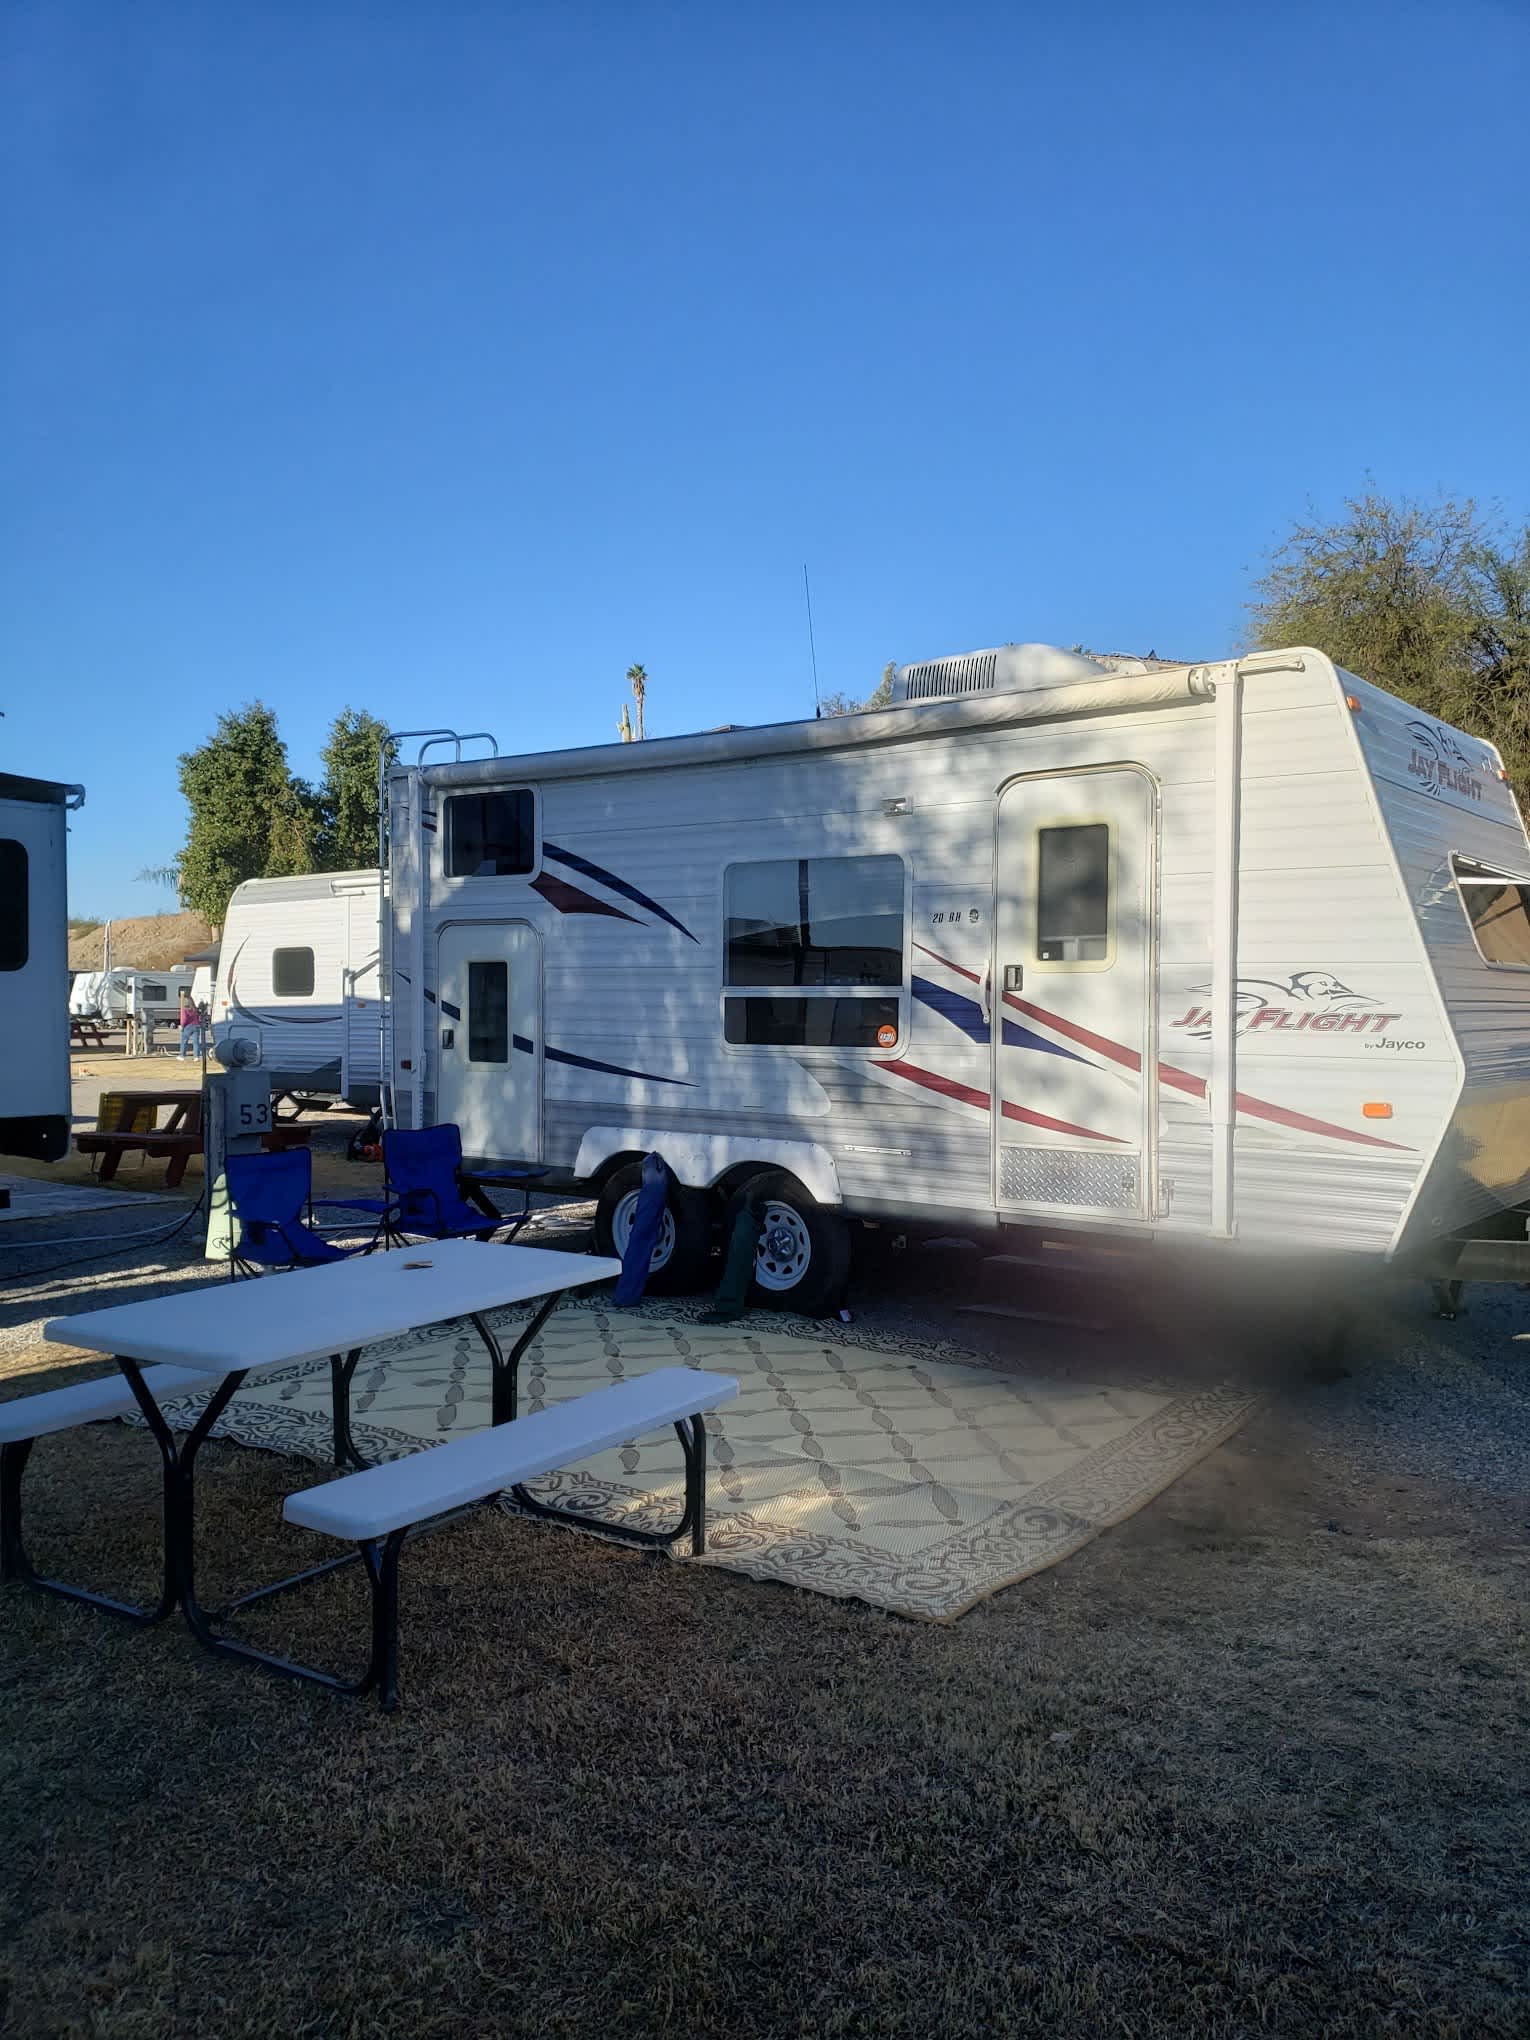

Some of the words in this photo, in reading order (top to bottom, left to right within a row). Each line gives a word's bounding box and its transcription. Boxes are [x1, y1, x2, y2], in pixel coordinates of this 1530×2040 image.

[932, 913, 943, 923] 20
[1246, 1008, 1402, 1032] FLIGHT
[1375, 1037, 1426, 1051] Jayco
[240, 1104, 268, 1124] 53
